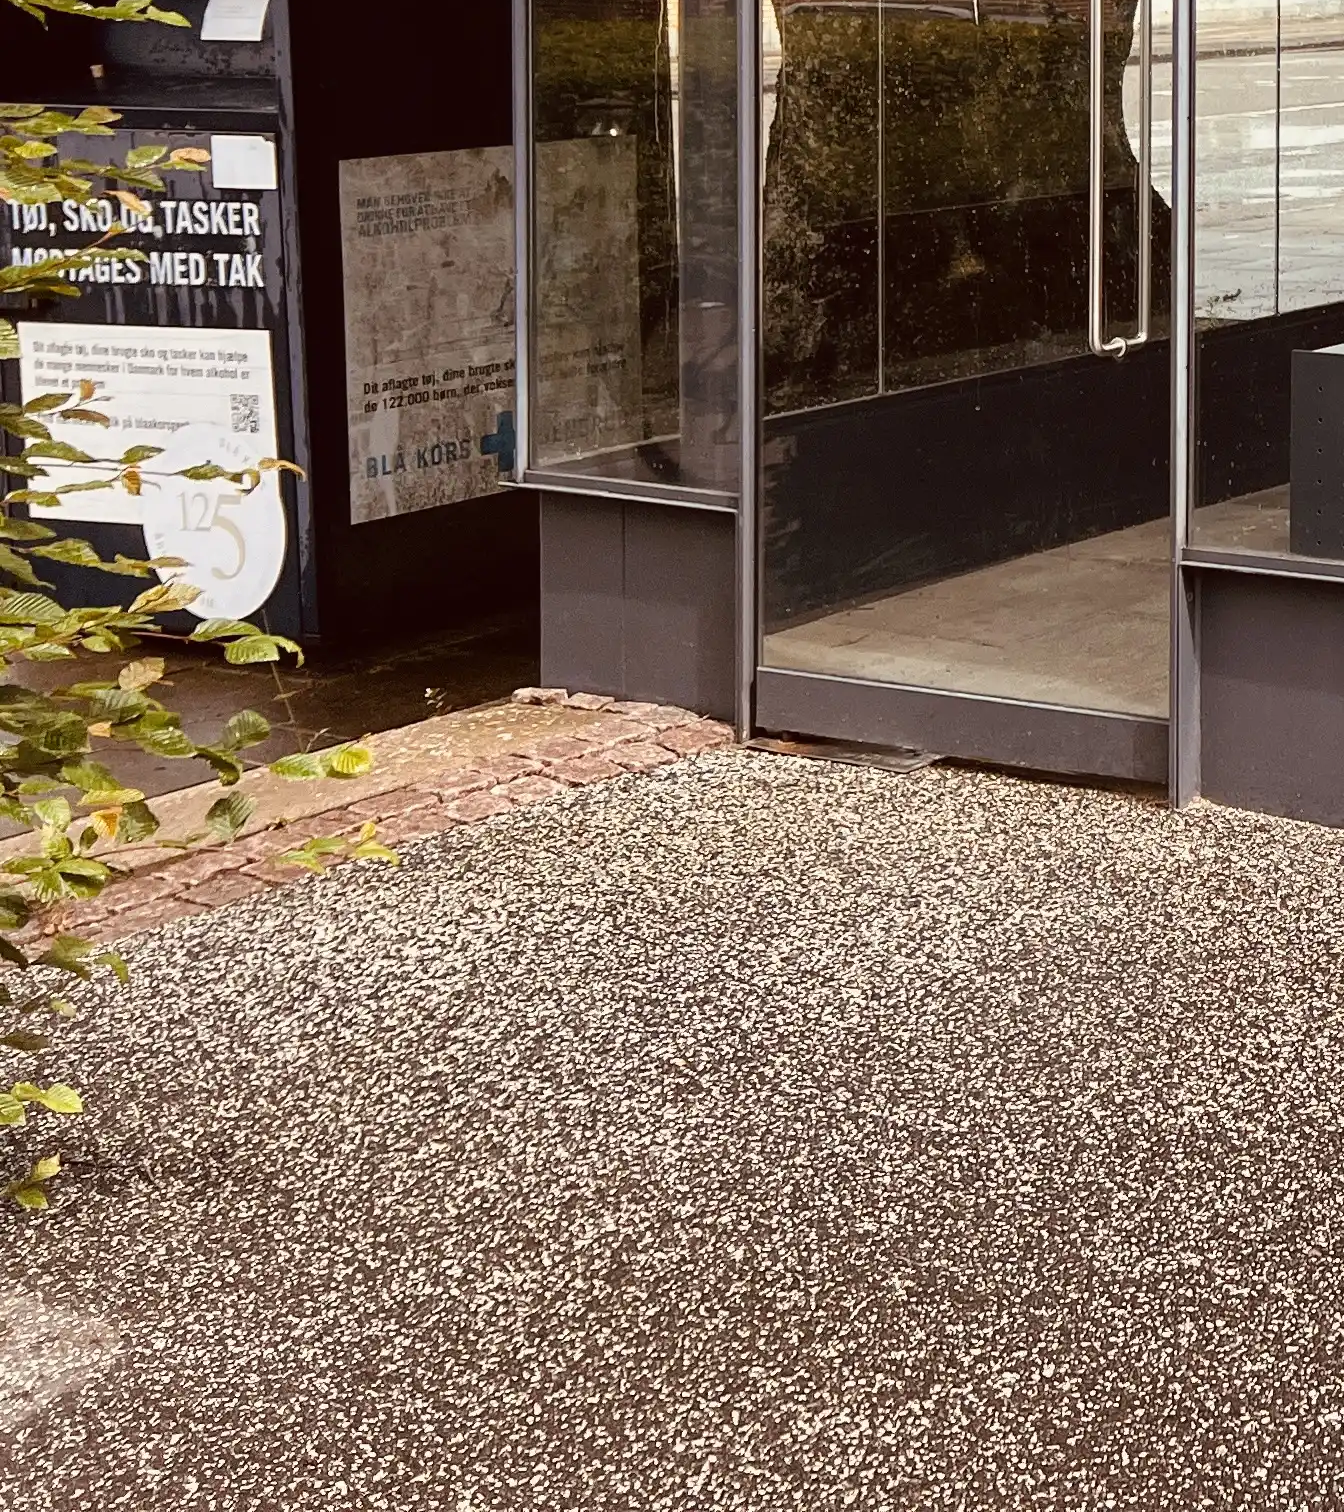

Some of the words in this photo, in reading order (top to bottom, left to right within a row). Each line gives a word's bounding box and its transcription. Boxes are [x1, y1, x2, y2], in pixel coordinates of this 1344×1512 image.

[7, 199, 57, 237] TØJ,
[62, 199, 112, 232] SKO
[159, 200, 261, 236] TASKER
[150, 251, 207, 287] MED
[212, 252, 265, 288] TAK
[363, 381, 380, 395] Dit
[382, 375, 419, 392] aflagte
[443, 368, 466, 382] dine
[468, 361, 501, 378] brugte
[382, 390, 430, 410] 122.000
[484, 376, 516, 392] vokse
[366, 444, 408, 479] BLÅ
[416, 438, 471, 470] KORS
[176, 490, 247, 581] 125
